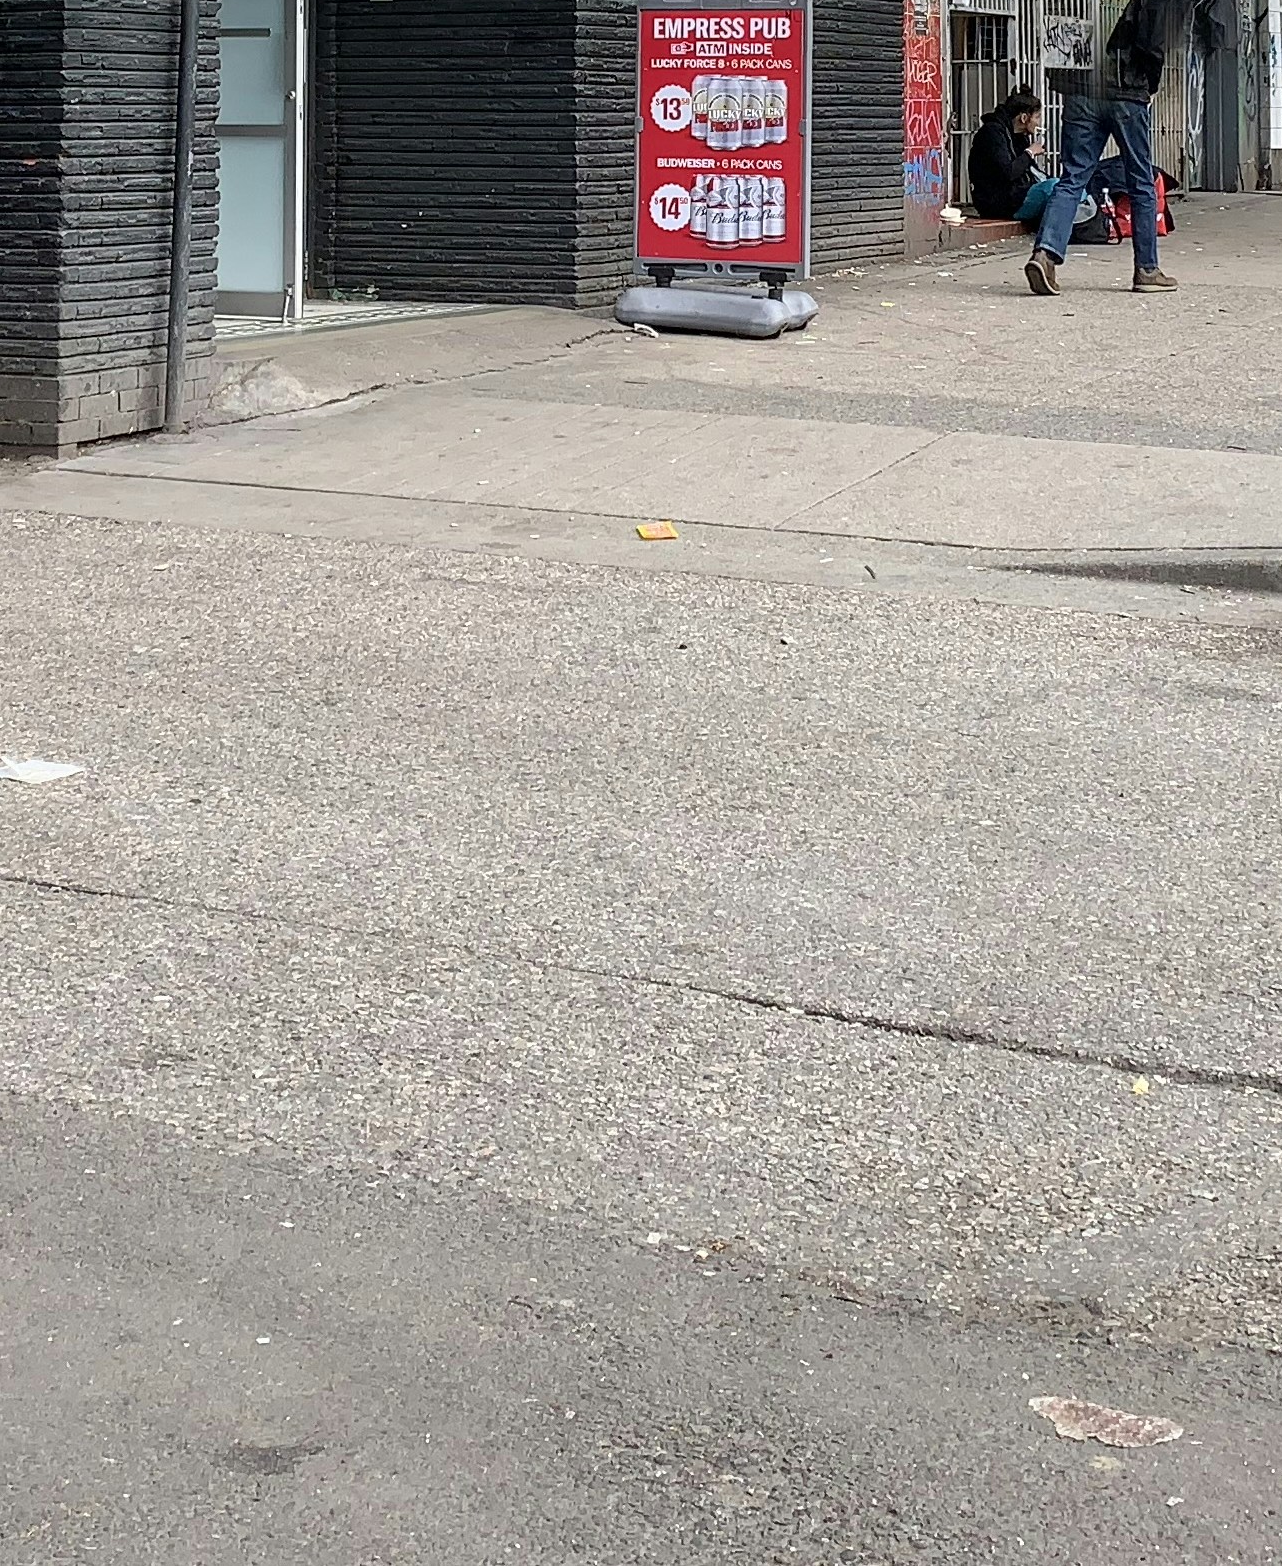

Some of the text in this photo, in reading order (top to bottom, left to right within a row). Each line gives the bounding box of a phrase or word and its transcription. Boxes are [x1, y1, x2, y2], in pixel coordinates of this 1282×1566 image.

[653, 17, 791, 39] EMPRESS PUB
[697, 42, 773, 55] ATM INSIDE
[651, 59, 683, 69] LUCKY
[684, 59, 716, 68] FORCE
[740, 59, 764, 69] PACK
[765, 59, 793, 69] CANS
[708, 109, 742, 119] LUCKY
[657, 158, 715, 169] BUDWEISER
[730, 159, 755, 170] PACK
[756, 160, 783, 170] CANS
